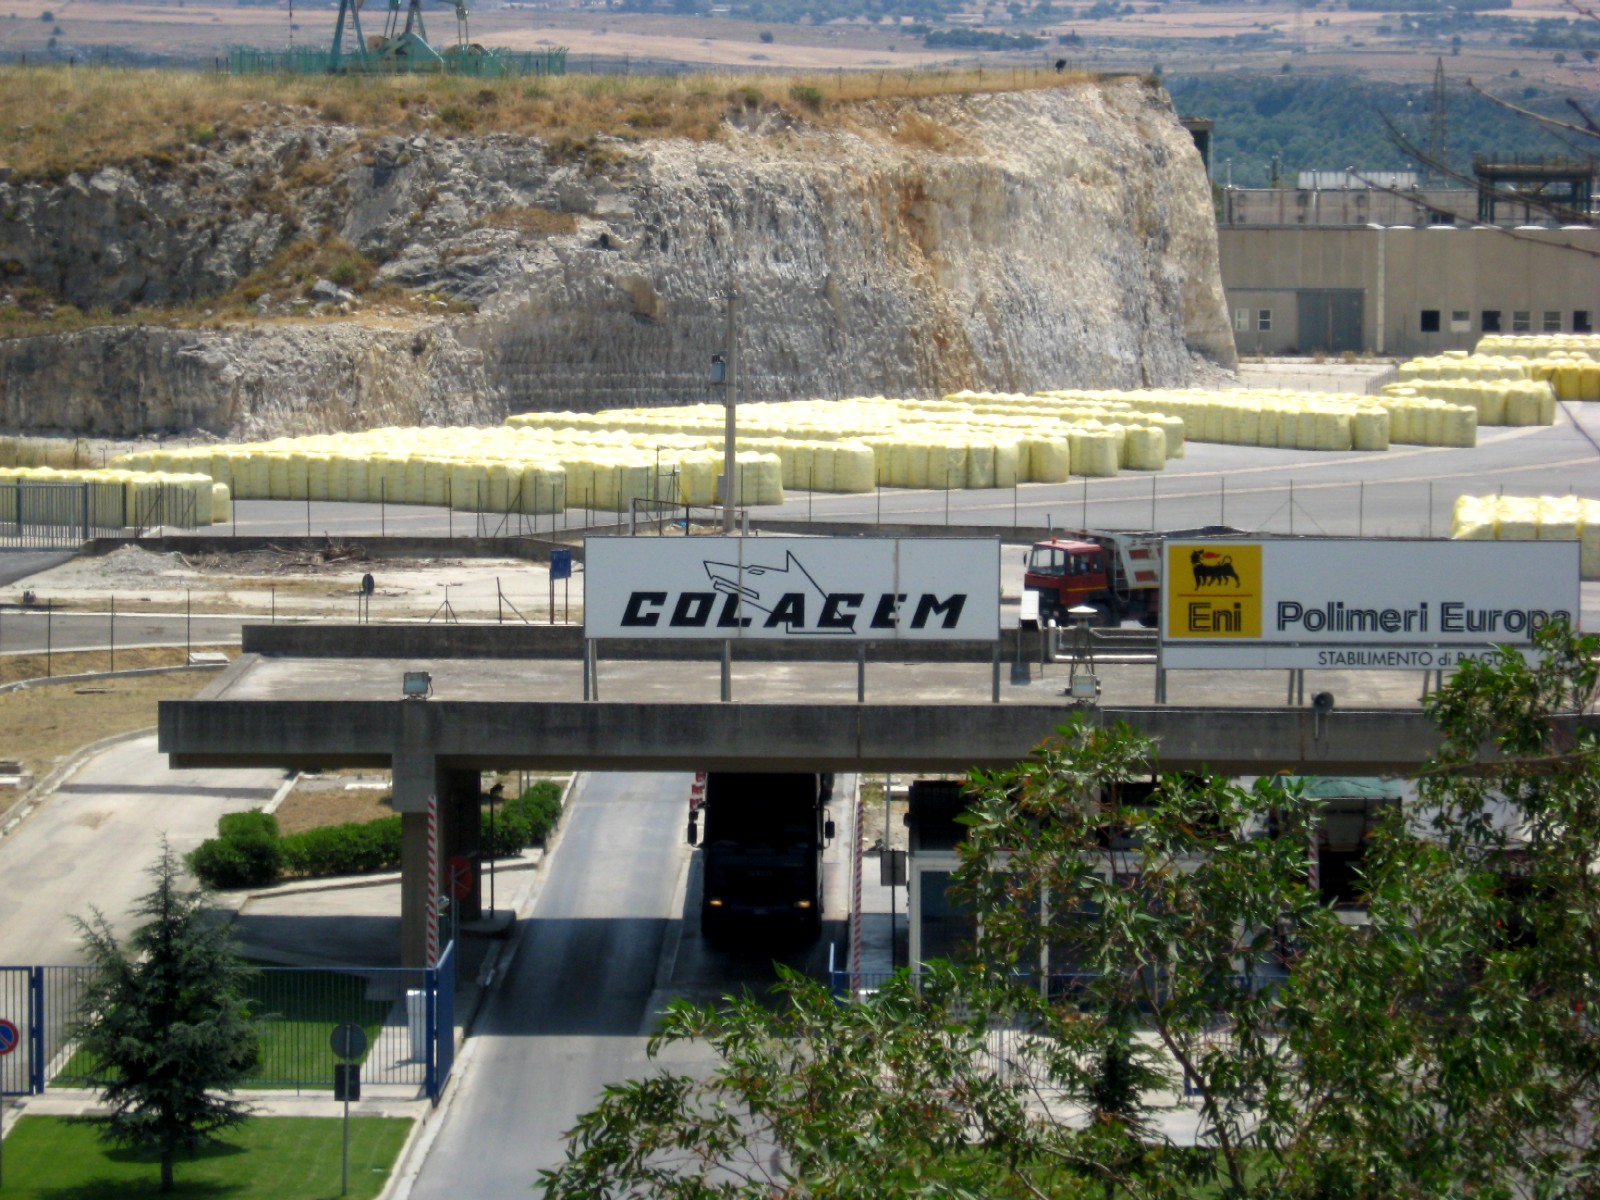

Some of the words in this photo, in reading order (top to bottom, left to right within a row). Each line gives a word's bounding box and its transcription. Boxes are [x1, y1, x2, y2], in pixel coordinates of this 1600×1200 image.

[620, 592, 968, 629] COLACEM
[1188, 602, 1242, 632] Eni
[1277, 601, 1428, 633] Polimeri
[1318, 651, 1433, 667] STABILIMENTO
[1438, 652, 1452, 666] di
